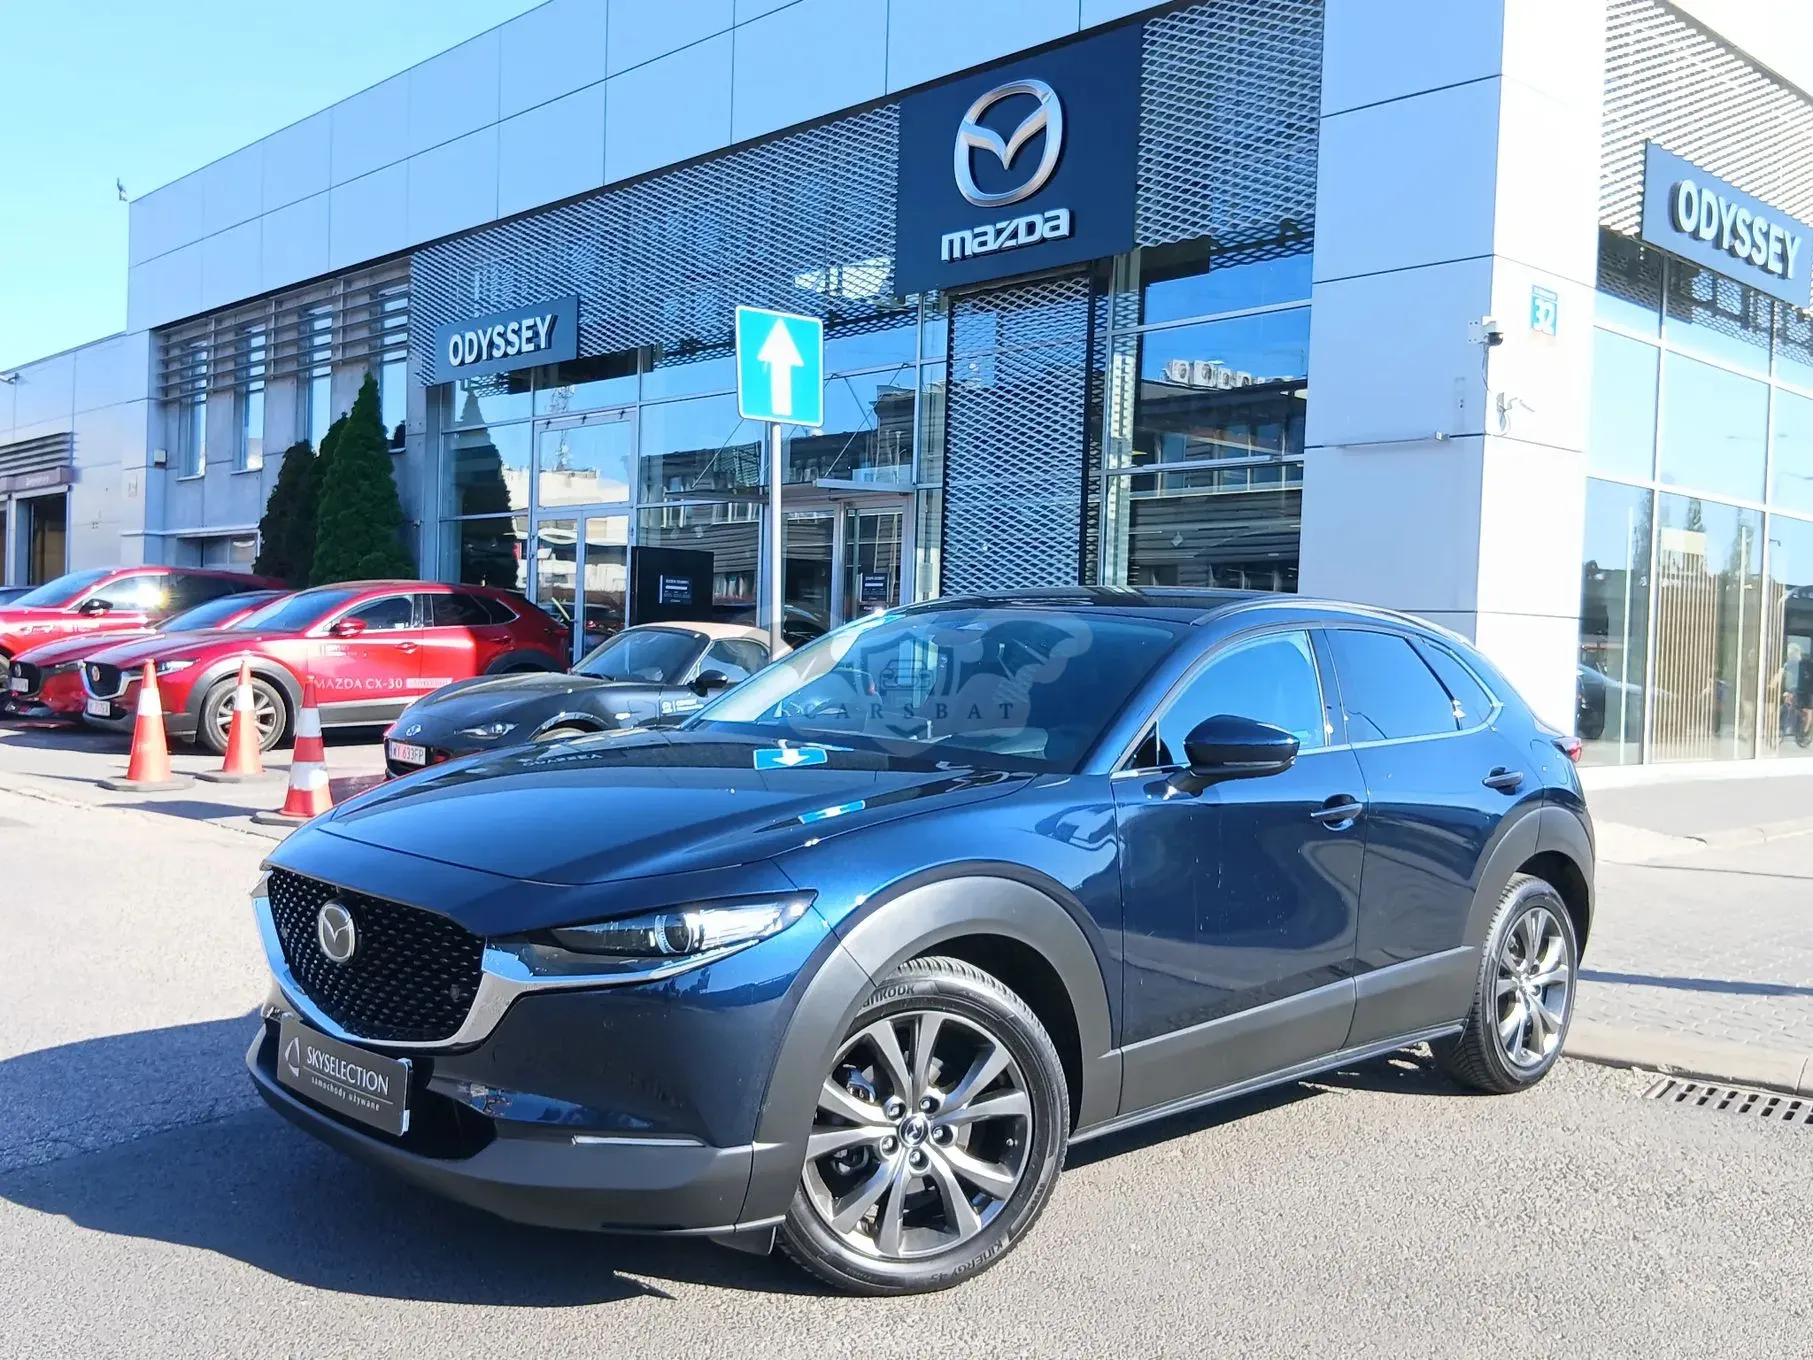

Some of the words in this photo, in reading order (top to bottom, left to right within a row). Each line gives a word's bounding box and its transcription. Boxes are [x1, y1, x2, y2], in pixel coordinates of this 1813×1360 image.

[1677, 179, 1802, 280] ODYSSEY
[1533, 298, 1556, 335] 32
[448, 313, 553, 367] ODYSSEY
[315, 677, 362, 689] MAZDA
[365, 676, 403, 689] CX-30
[307, 1046, 389, 1095] SKYSELECTION
[311, 1076, 346, 1100] samochody
